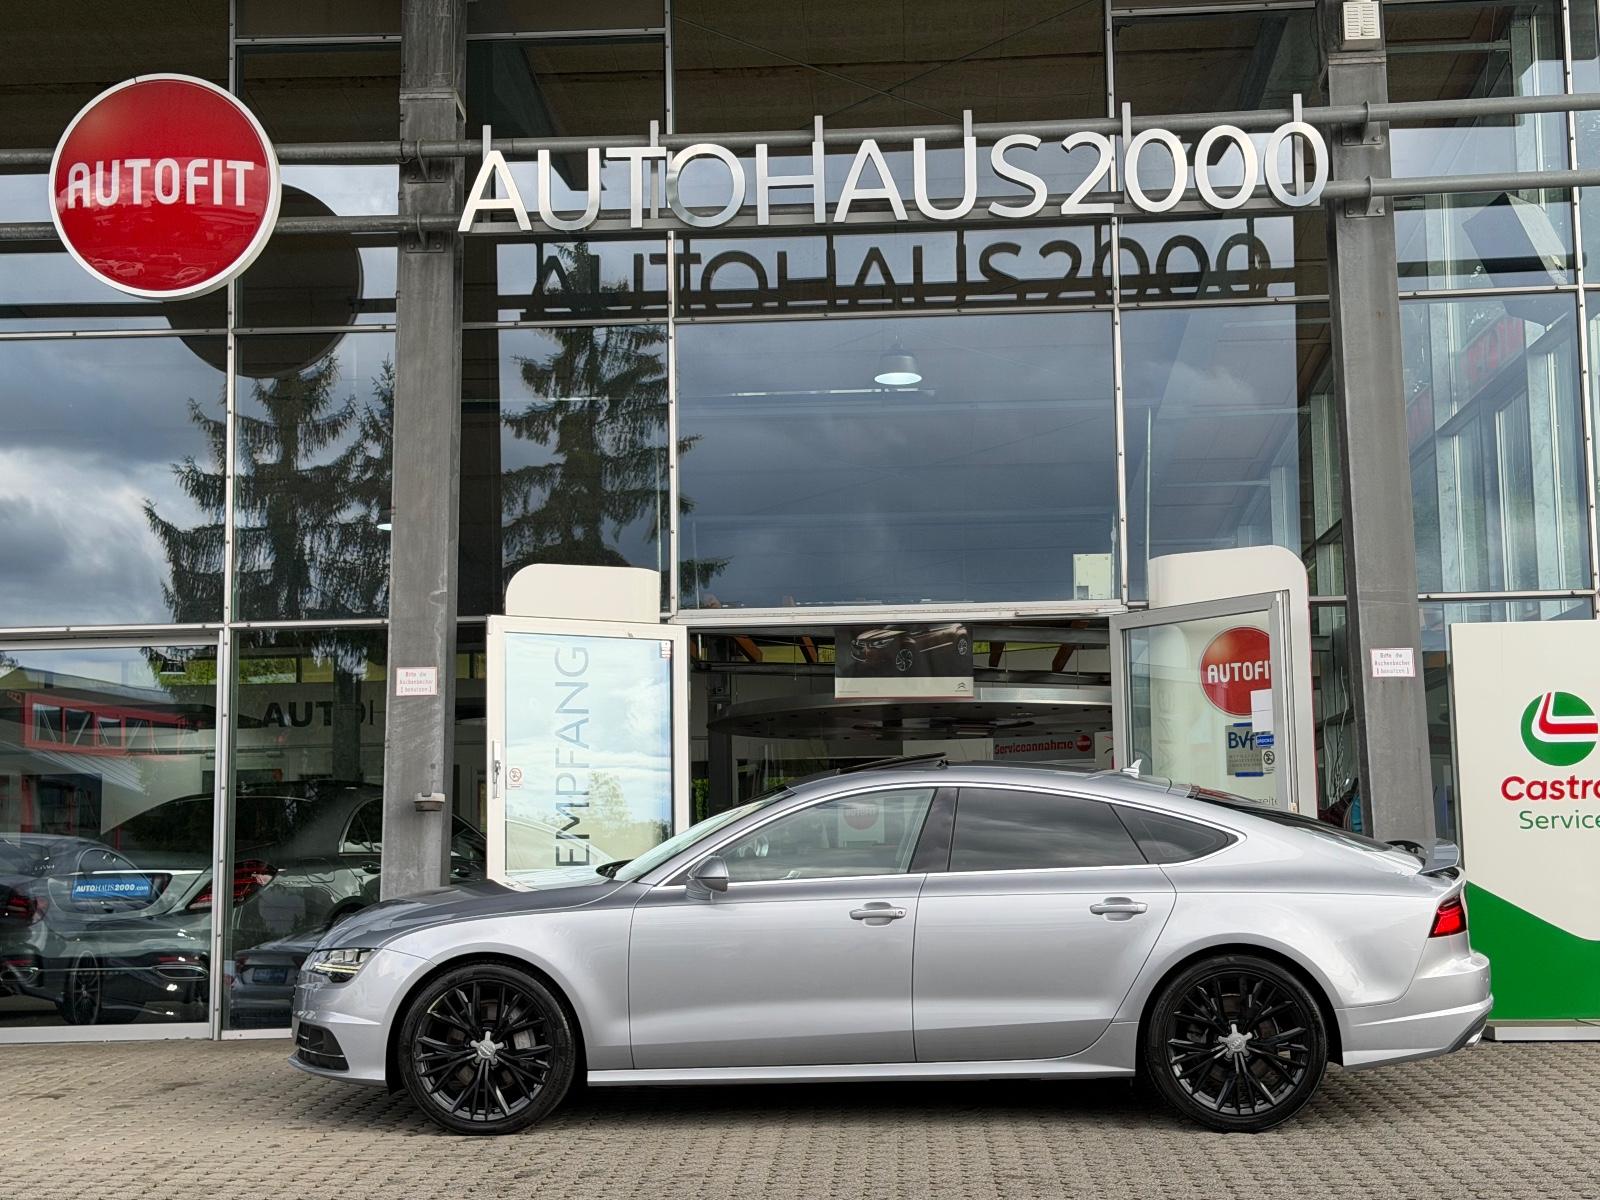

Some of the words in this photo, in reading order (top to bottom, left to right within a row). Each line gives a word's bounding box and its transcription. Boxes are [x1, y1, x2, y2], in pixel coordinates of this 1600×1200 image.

[67, 158, 255, 208] AUTOFIT
[458, 121, 1329, 231] AUTOHAUS2000
[1207, 660, 1272, 684] AUTOFI
[554, 646, 590, 866] EMPFANG
[994, 740, 1074, 754] Serviceannahme
